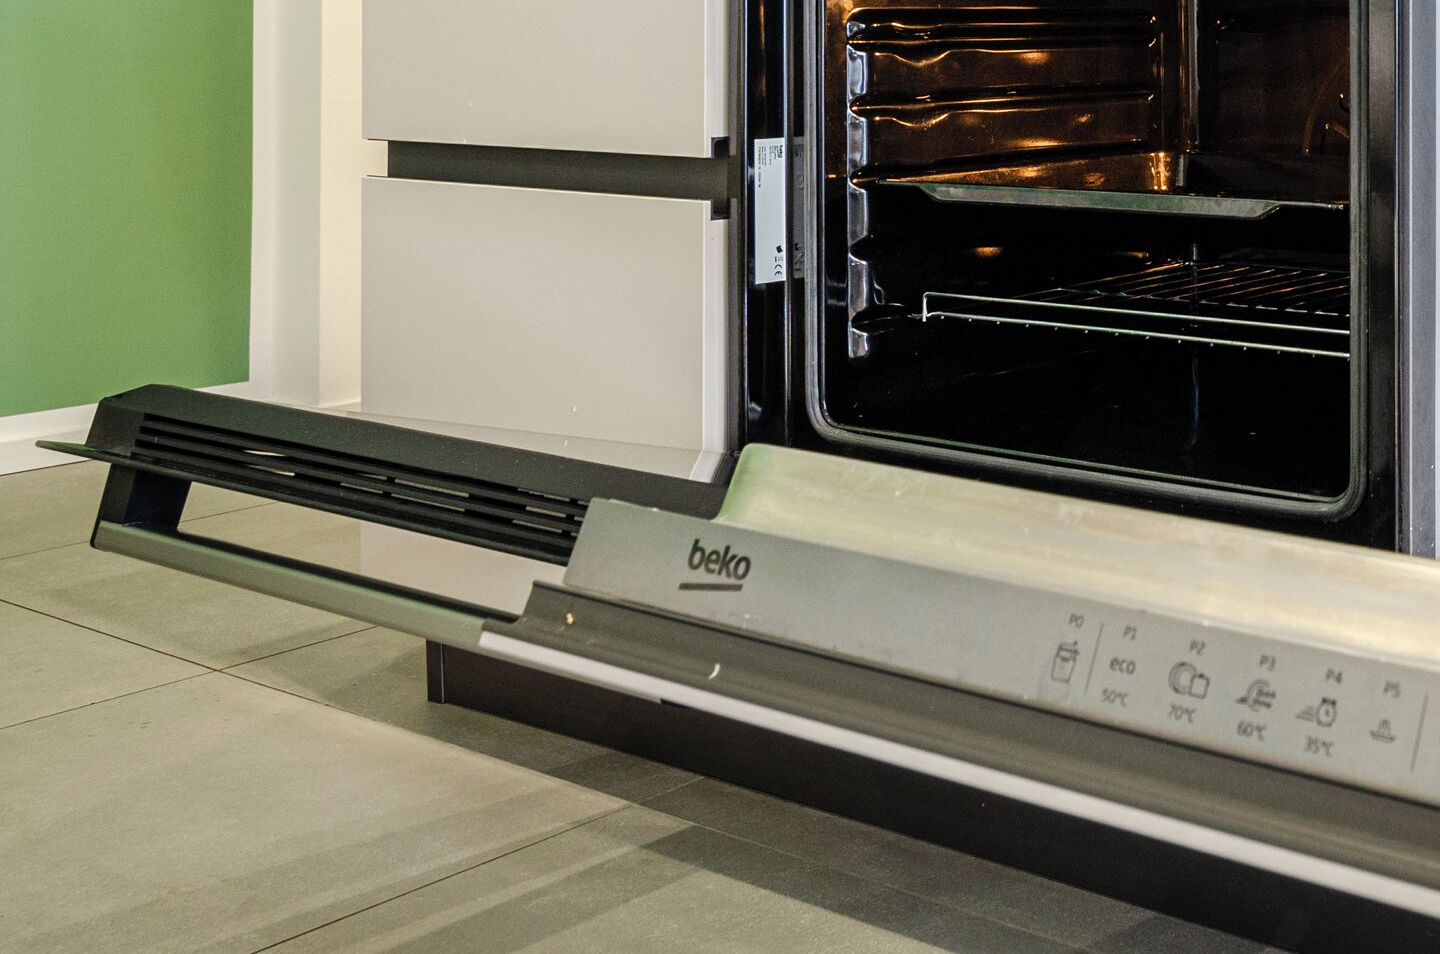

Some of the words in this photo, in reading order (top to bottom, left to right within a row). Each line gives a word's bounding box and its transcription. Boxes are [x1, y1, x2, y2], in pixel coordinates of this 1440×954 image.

[687, 538, 751, 581] beko
[1123, 625, 1137, 641] P1
[1189, 639, 1206, 656] P2
[1109, 656, 1136, 675] eco
[1258, 654, 1276, 671] P3
[1325, 667, 1343, 684] P4
[1383, 680, 1401, 698] P5
